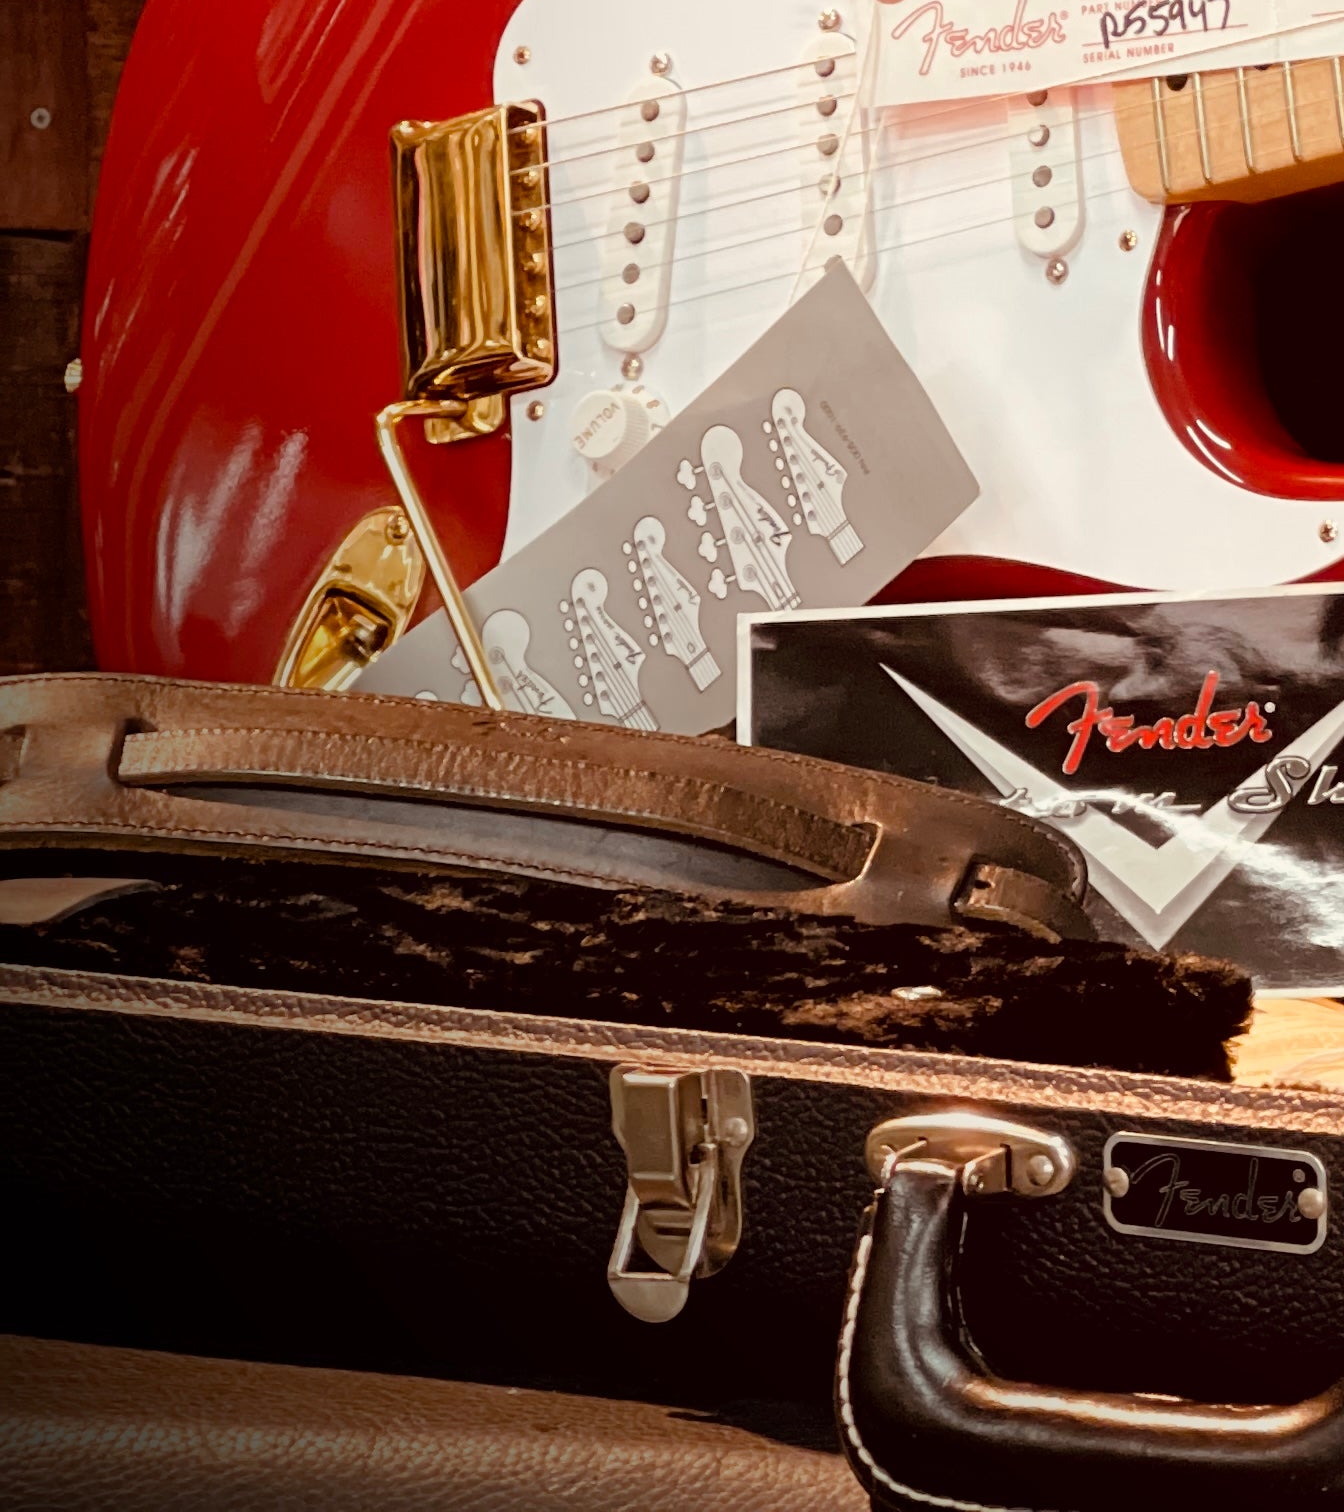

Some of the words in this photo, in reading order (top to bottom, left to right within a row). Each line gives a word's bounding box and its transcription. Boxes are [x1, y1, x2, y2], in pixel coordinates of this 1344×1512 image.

[1081, 2, 1109, 16] PART
[1082, 48, 1121, 64] SERIAL
[1126, 42, 1175, 58] NUMBER
[960, 64, 996, 79] SINCE
[1001, 60, 1032, 74] 1946
[1025, 669, 1274, 776] Fender
[1129, 1152, 1303, 1228] Fender
